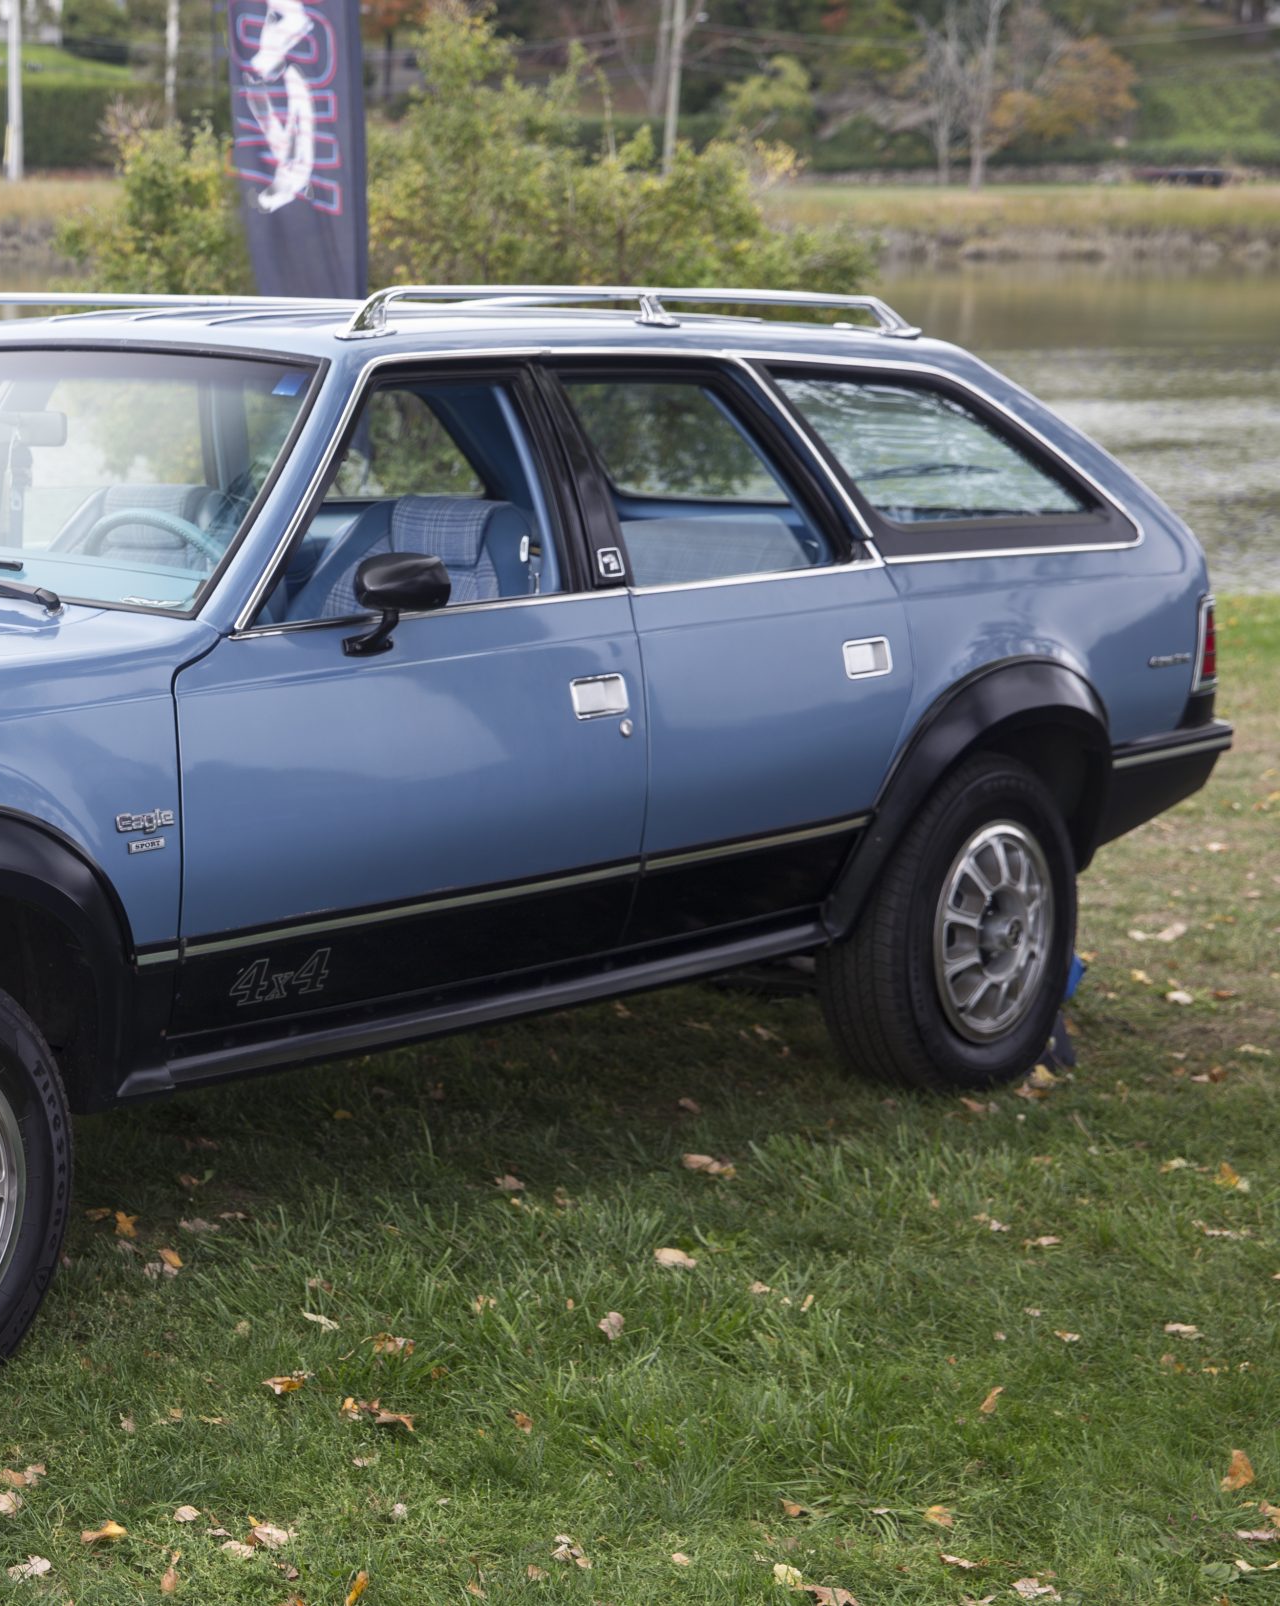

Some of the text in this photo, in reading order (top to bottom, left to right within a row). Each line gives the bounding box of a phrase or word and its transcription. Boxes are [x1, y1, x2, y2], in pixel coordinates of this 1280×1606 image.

[115, 808, 174, 834] Eagle
[135, 840, 161, 850] SPORT
[229, 947, 332, 1007] 4x4
